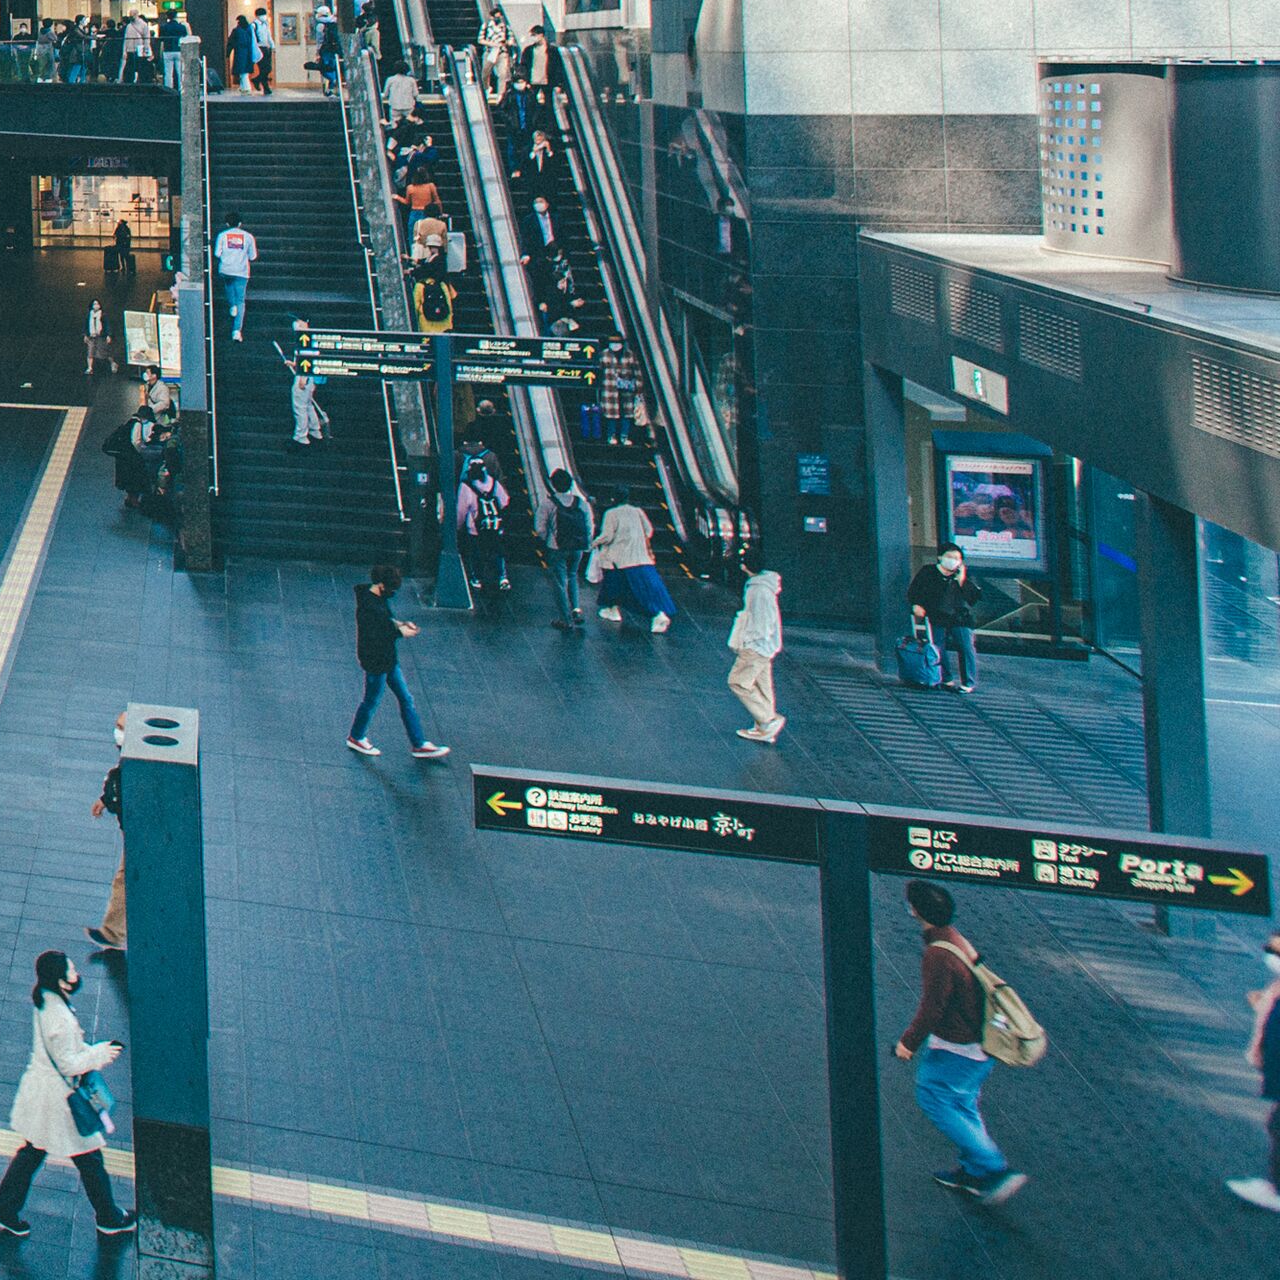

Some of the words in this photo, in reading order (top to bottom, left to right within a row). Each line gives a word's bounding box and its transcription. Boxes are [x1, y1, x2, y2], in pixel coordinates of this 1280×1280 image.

[547, 789, 604, 807] 鉄道案内所
[576, 803, 618, 815] Information
[569, 813, 603, 828] お手洗
[632, 812, 709, 831] おみやげ小路
[712, 812, 756, 841] 京小町
[568, 823, 603, 835] Lavatory
[933, 830, 958, 843] バス
[933, 840, 951, 850] Bus
[1058, 842, 1108, 856] タクシー
[933, 852, 1021, 873] バス総合案内所
[1059, 852, 1080, 864] Taxi
[933, 862, 953, 873] Bus
[953, 864, 1001, 878] Information
[1059, 864, 1100, 881] 地下鉄
[1119, 852, 1205, 881] Porta
[1059, 874, 1096, 889] Subway
[1130, 876, 1175, 893] Shopping
